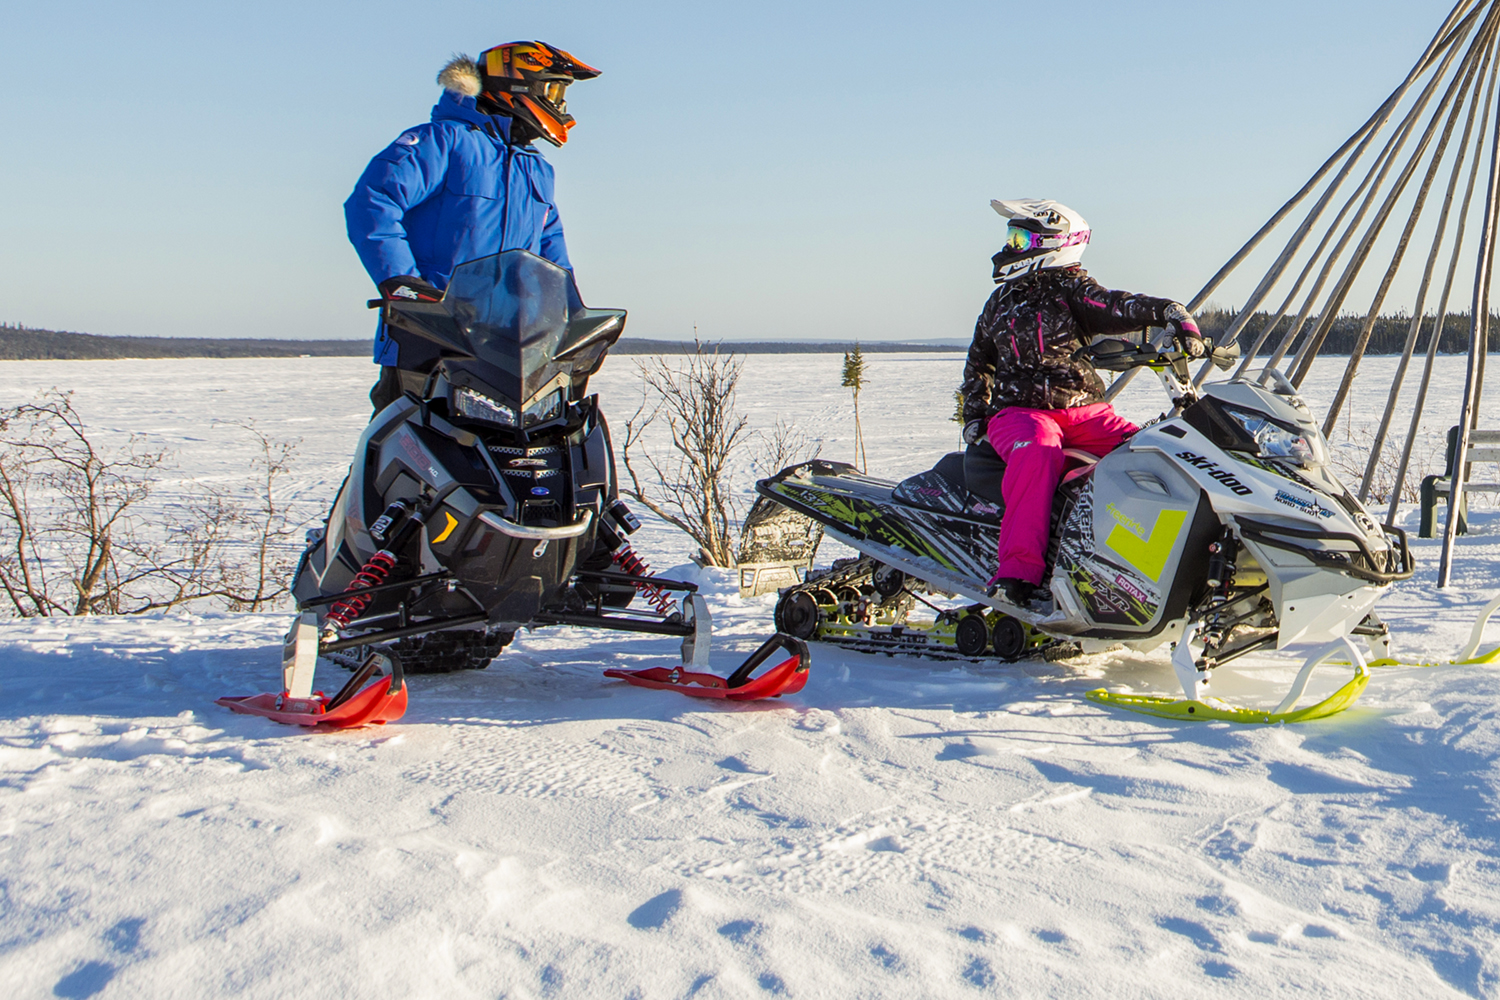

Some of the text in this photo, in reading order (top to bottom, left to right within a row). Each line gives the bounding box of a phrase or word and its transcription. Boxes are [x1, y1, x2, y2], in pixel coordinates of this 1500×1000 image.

[1013, 258, 1033, 270] 509
[1175, 451, 1254, 496] ski-doo
[800, 490, 828, 506] 137
[1275, 497, 1316, 517] NORD SUD
[1105, 502, 1146, 537] freeride
[1090, 579, 1131, 612] FXR
[1117, 577, 1146, 601] ROTAX
